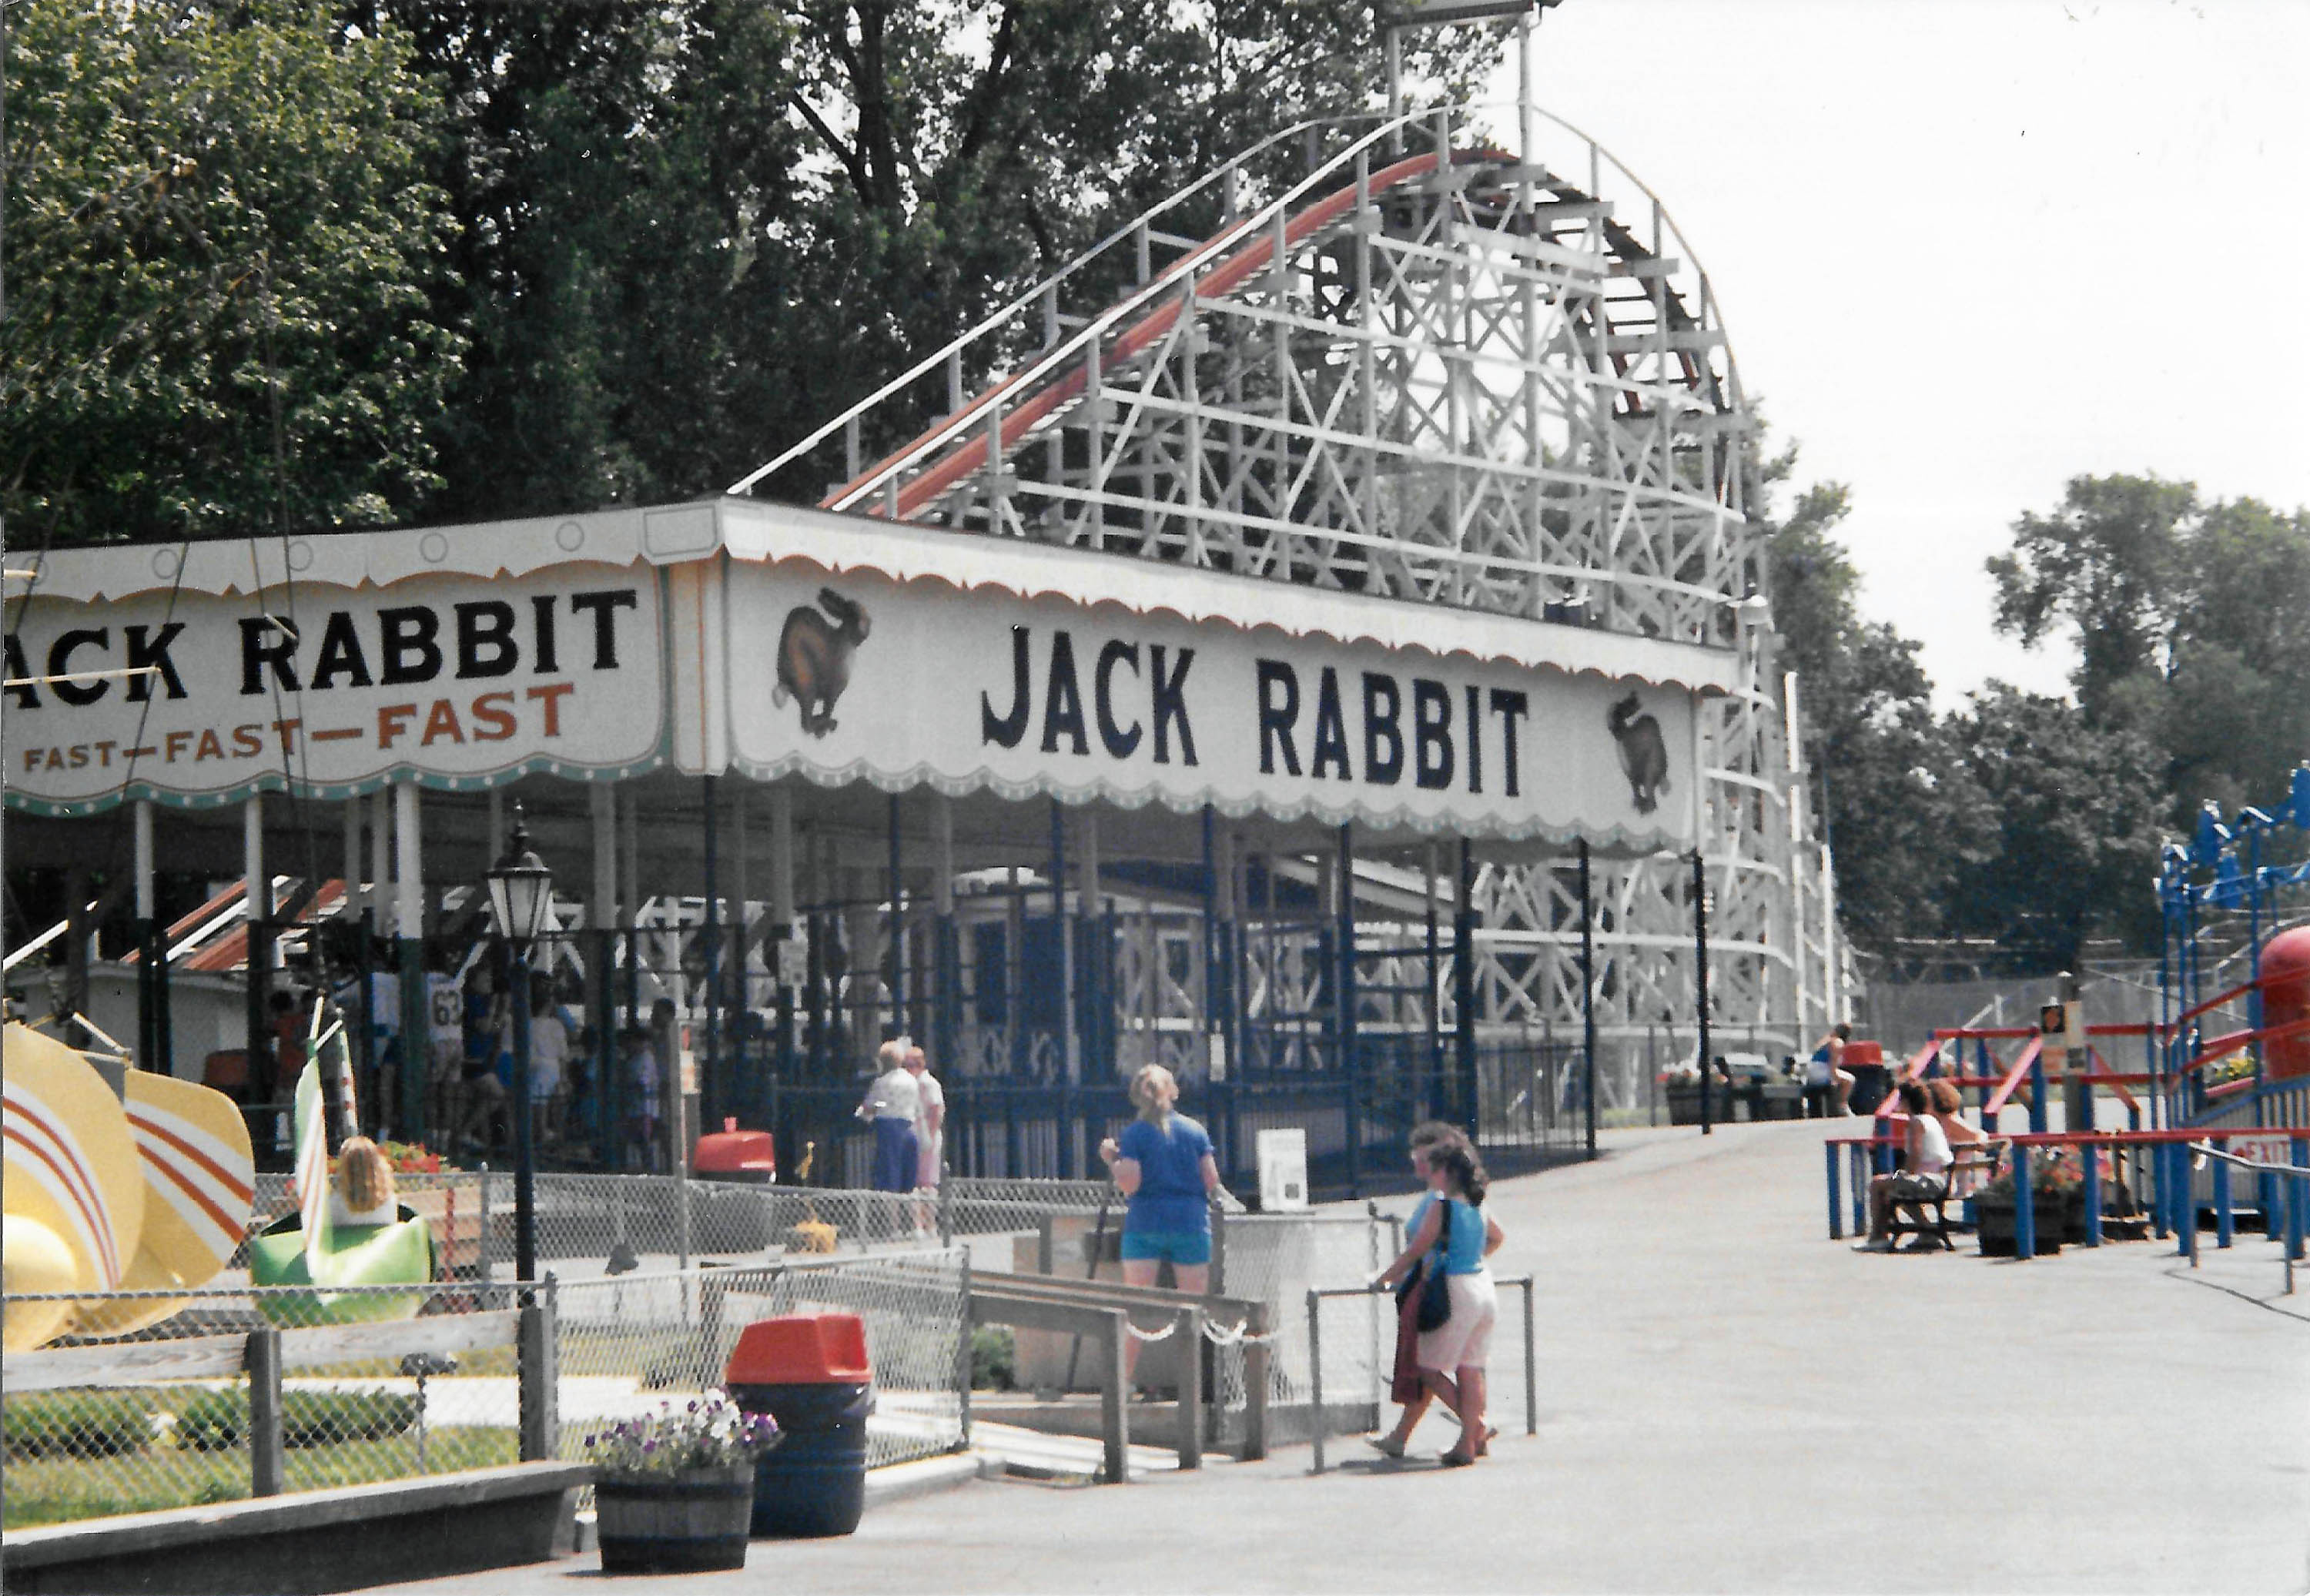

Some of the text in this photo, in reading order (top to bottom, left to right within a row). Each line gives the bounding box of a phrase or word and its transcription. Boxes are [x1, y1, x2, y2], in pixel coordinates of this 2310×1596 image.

[239, 589, 636, 696] RABBIT
[981, 627, 1529, 797] JACK RABBIT
